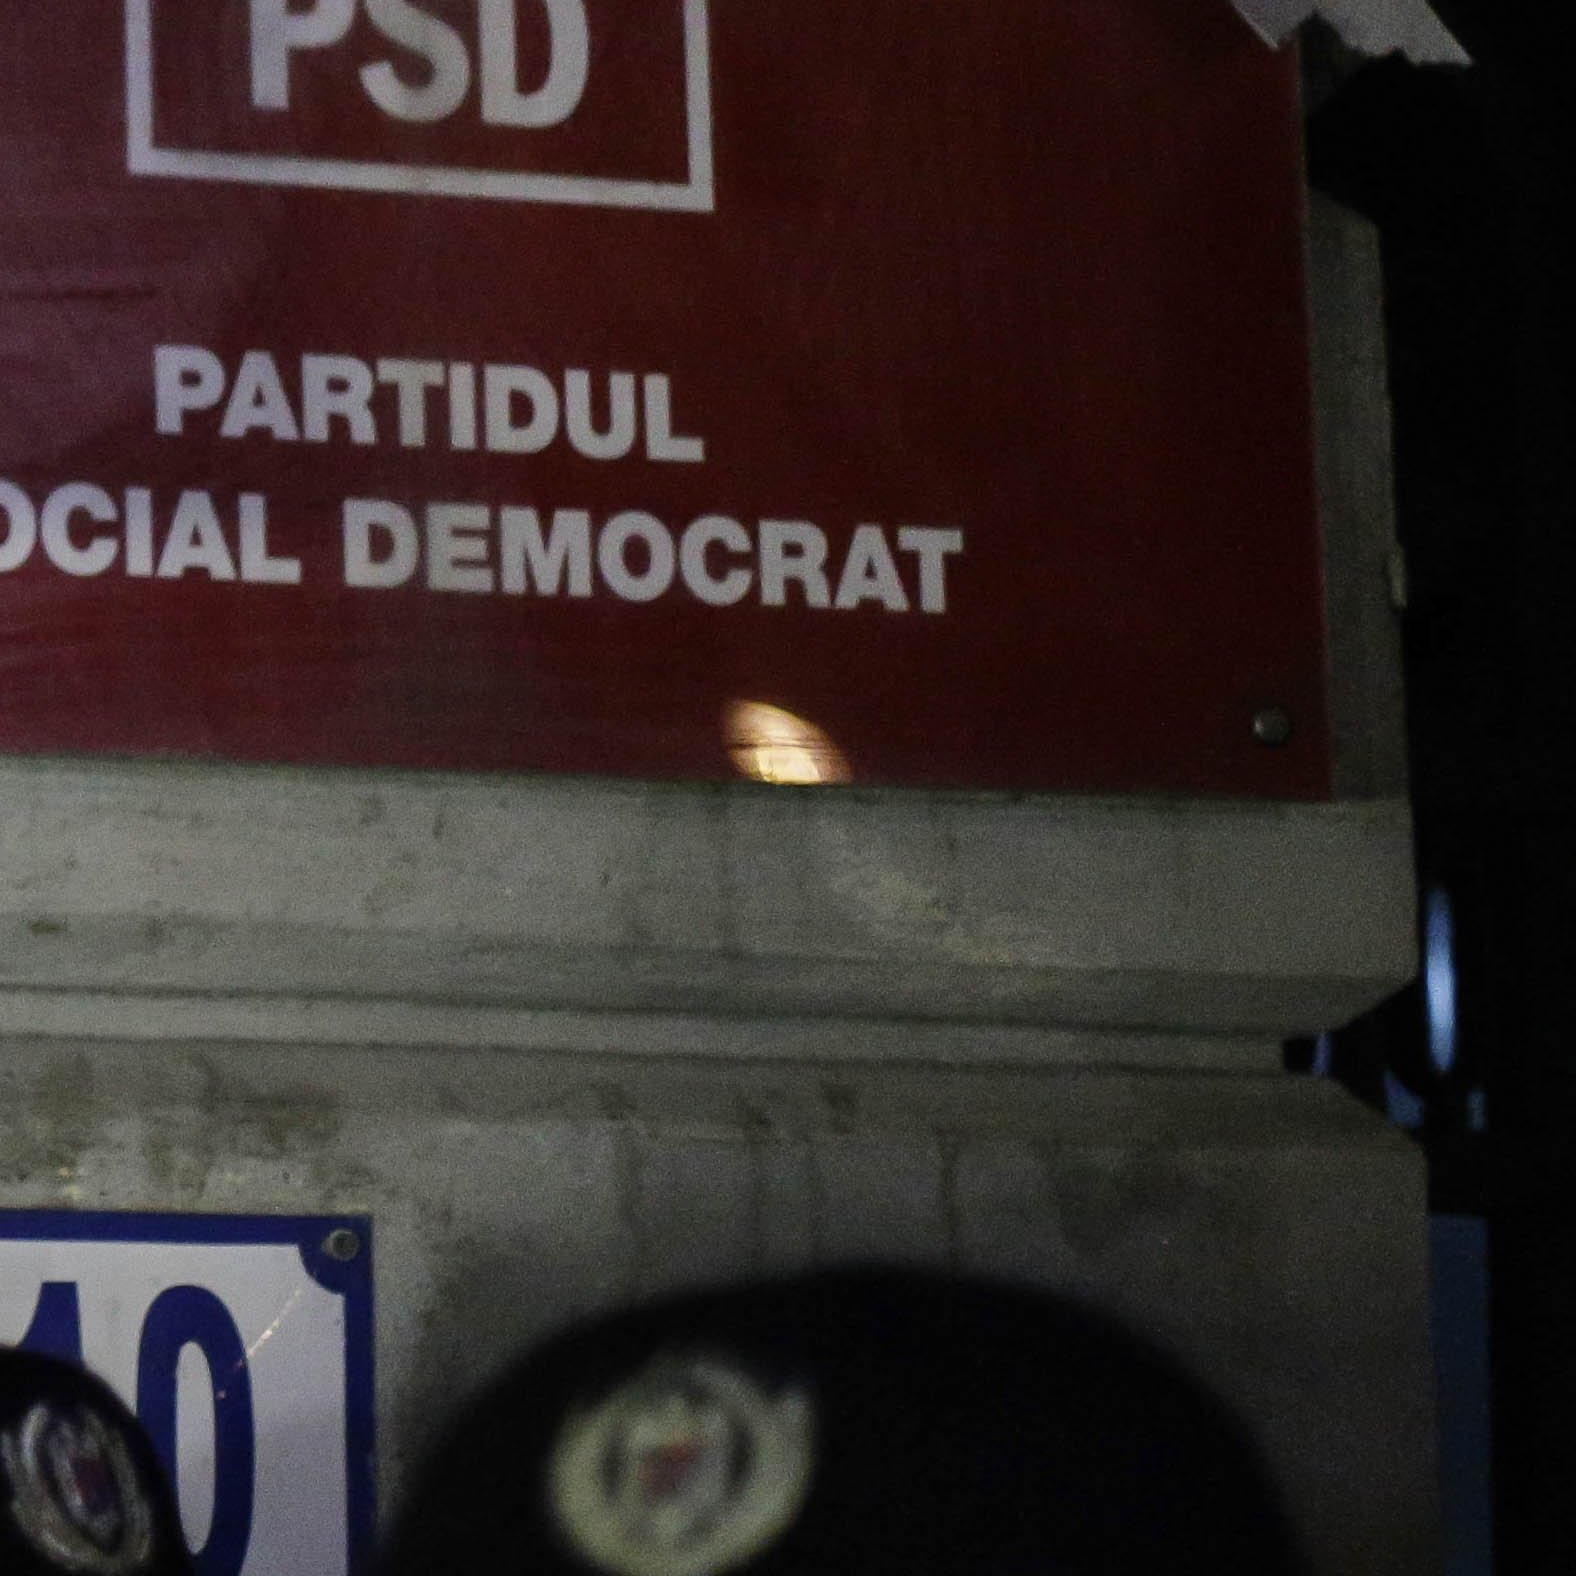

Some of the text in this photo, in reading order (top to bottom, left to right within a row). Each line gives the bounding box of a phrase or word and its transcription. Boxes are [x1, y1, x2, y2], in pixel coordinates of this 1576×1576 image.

[153, 344, 706, 463] PARTIDUL
[342, 497, 964, 614] DEMOCRAT
[16, 1281, 255, 1576] 0
